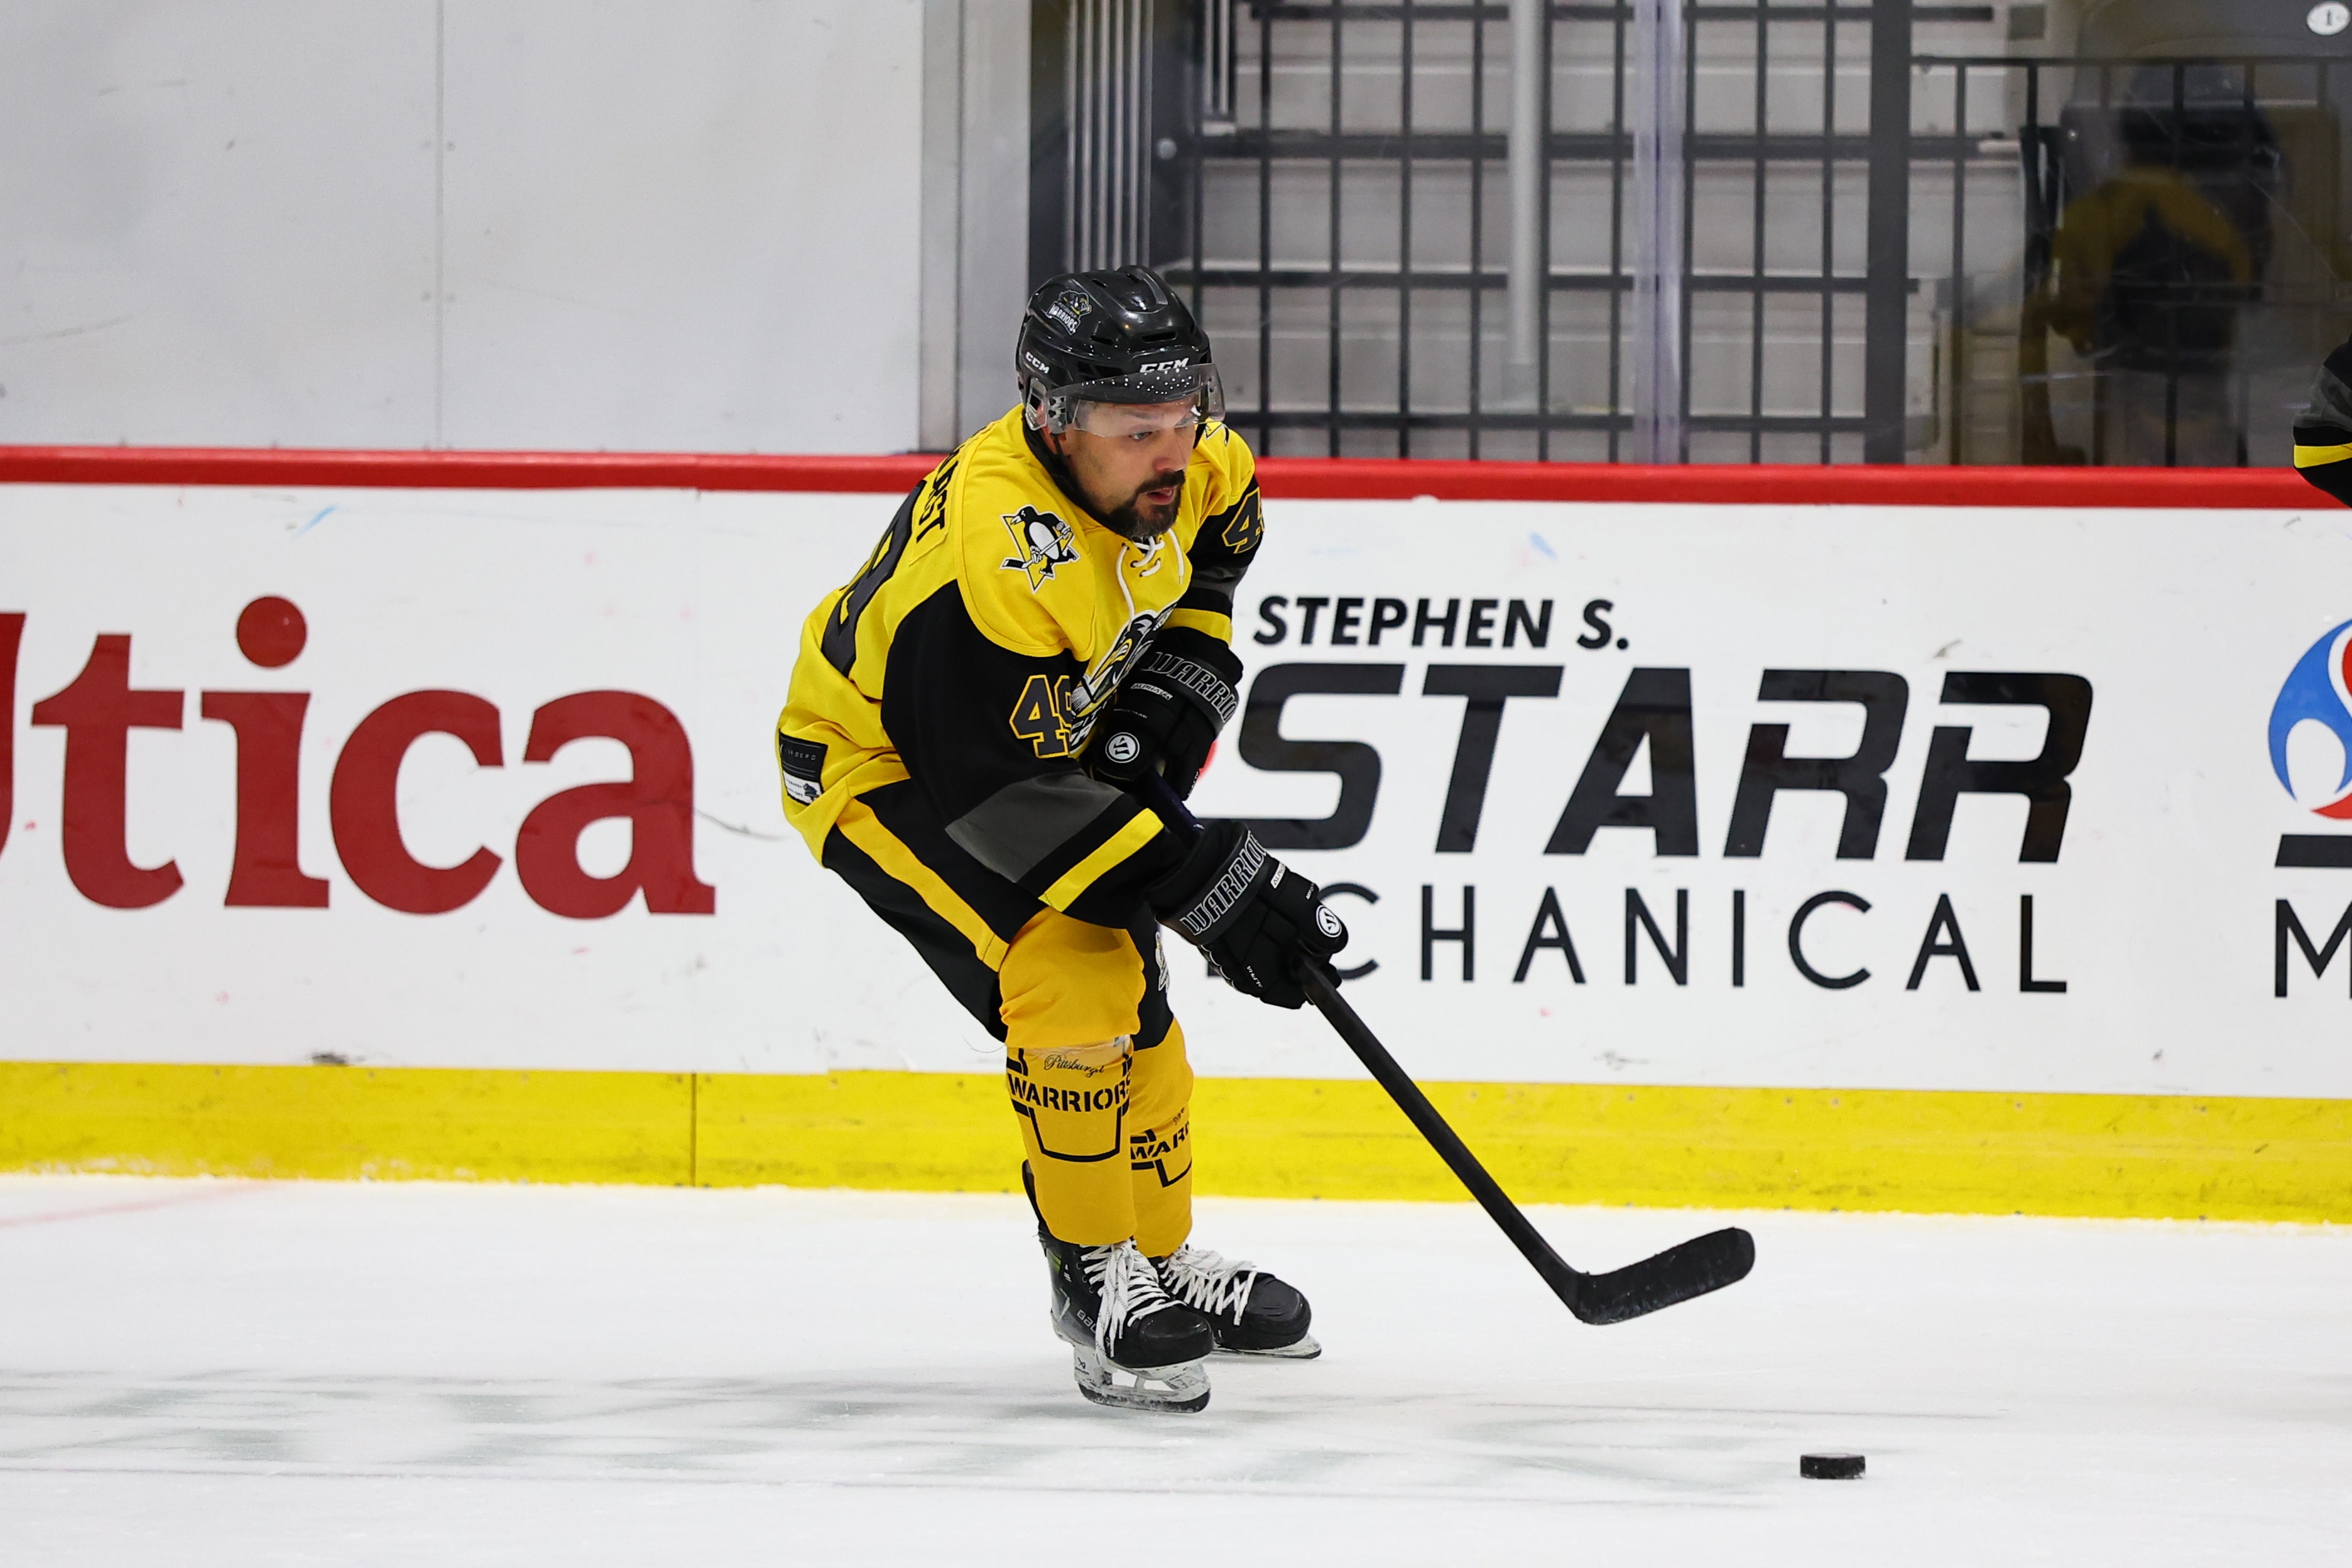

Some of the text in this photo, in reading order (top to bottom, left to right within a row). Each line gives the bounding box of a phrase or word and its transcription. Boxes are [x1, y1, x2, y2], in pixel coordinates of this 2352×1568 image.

[1048, 303, 1078, 332] WARRIORS
[1026, 351, 1050, 374] CCM
[1140, 357, 1189, 374] CCM
[1253, 596, 1629, 650] STEPHEN S.
[1141, 651, 1237, 723] WARRIO
[0, 596, 716, 919] tica
[1195, 662, 2093, 863] STARR
[1179, 830, 1267, 936] WARRIO
[1208, 881, 2067, 994] CHANICAL
